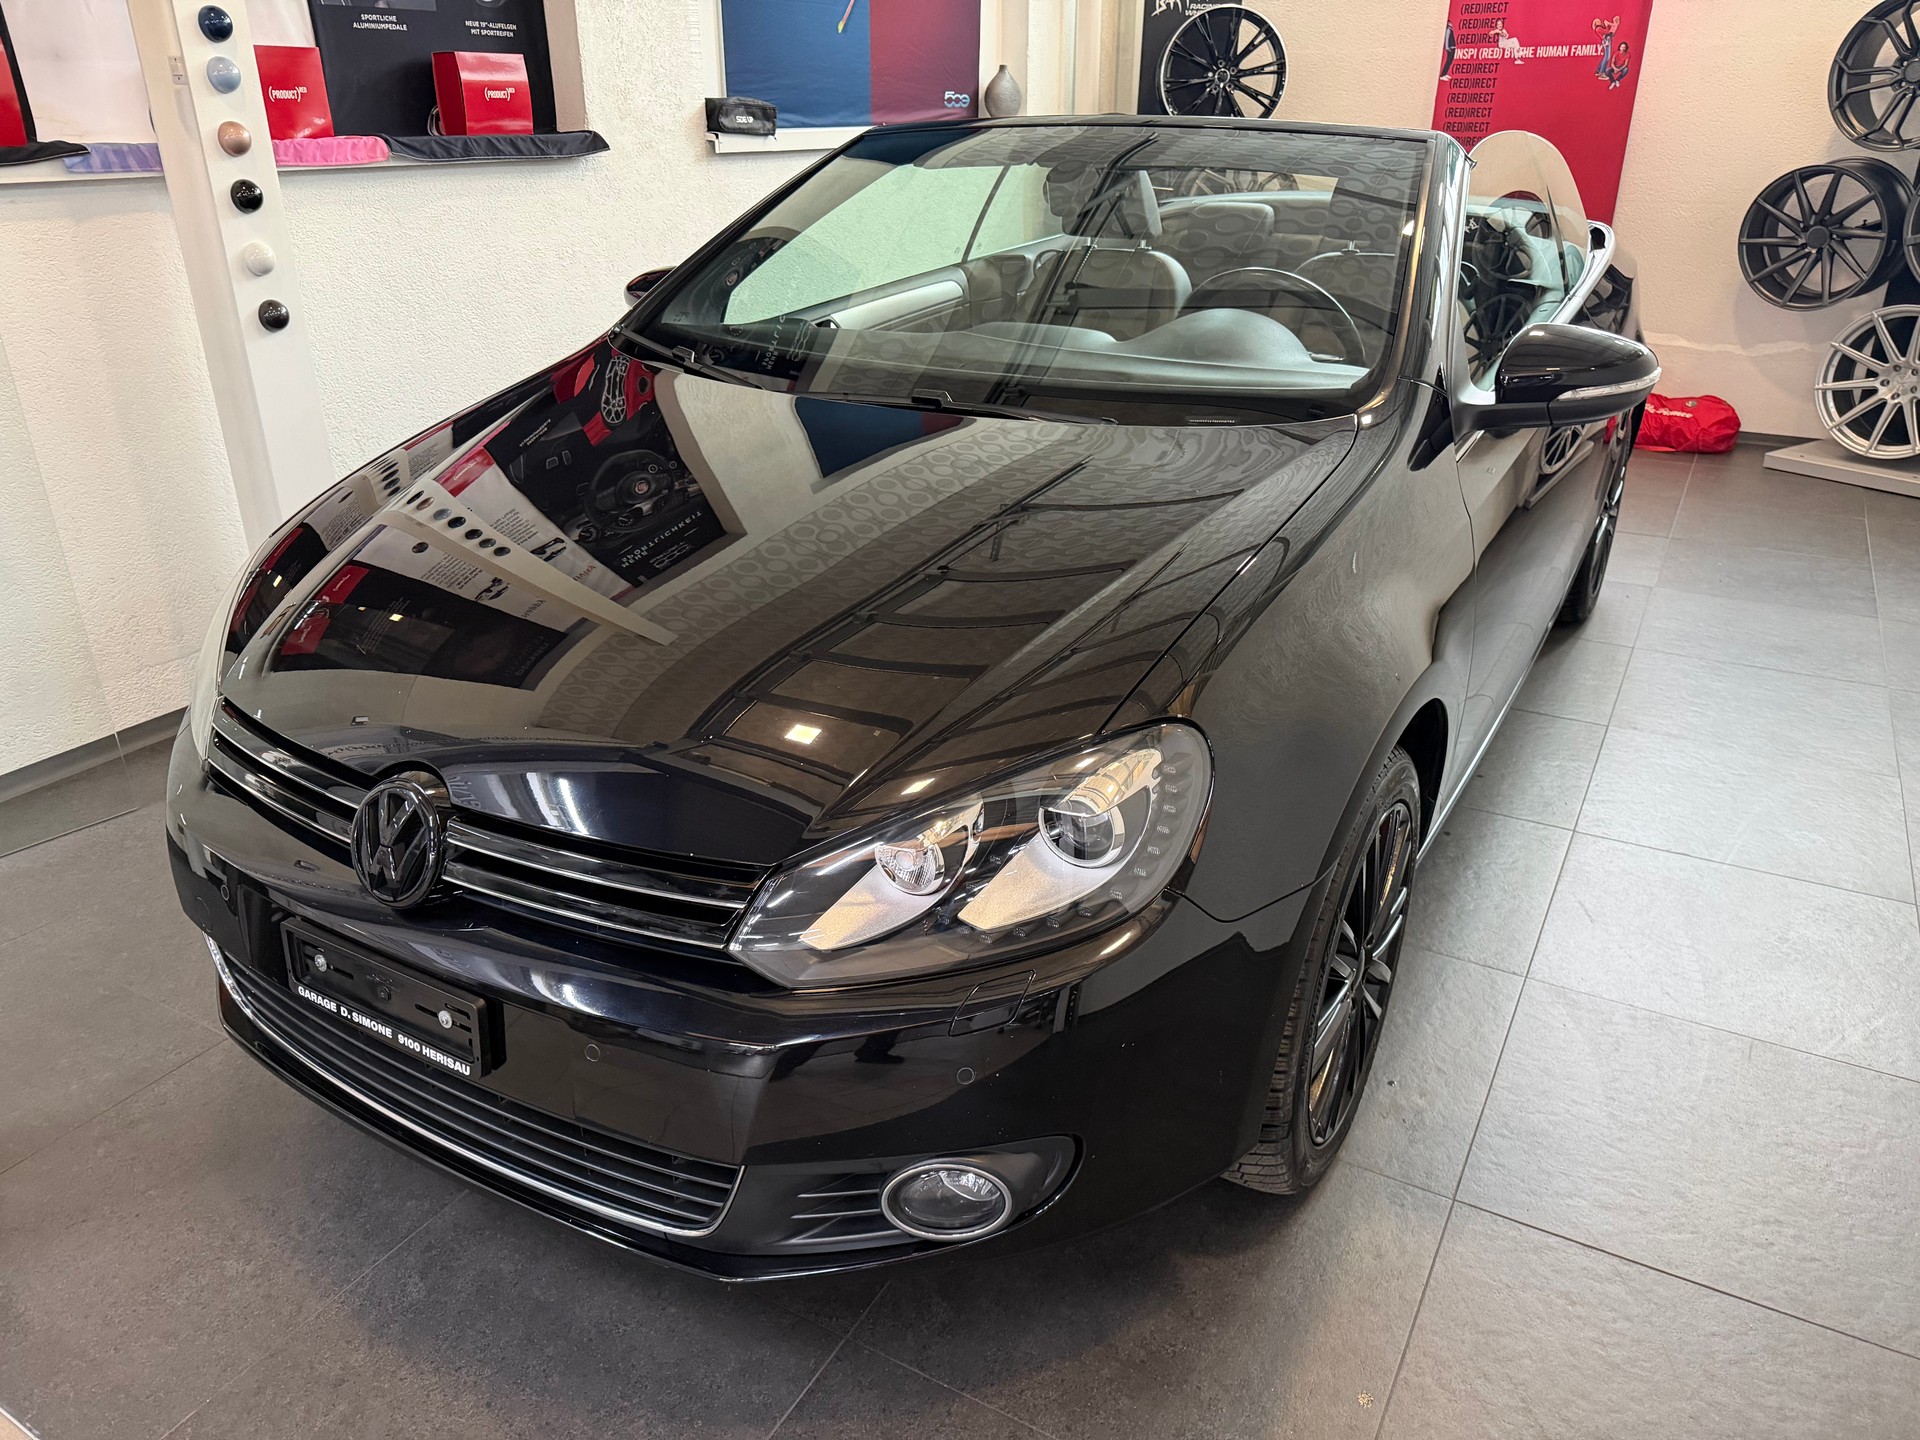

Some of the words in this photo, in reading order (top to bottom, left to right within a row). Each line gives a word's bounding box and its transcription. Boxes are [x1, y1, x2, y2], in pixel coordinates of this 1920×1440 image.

[1461, 2, 1508, 15] (RED)IRECT
[360, 13, 397, 22] SPORTLICHE
[352, 22, 408, 31] ALUMINIUMPEDALE
[481, 29, 514, 37] SPORTREIFEN
[1457, 33, 1500, 45] (RED)IREC
[1479, 48, 1503, 60] (RED)
[1536, 46, 1569, 57] HUMAN
[1452, 63, 1500, 75] (RED)IRECT
[1449, 77, 1497, 90] (RED)IRECT
[1447, 92, 1495, 104] (RED)IRECT
[1445, 107, 1492, 118] (RED)IRECT
[297, 986, 338, 1013] GARAGE
[340, 1006, 351, 1019] D.
[352, 1012, 393, 1039] SIMONE
[398, 1034, 421, 1053] 9100
[422, 1045, 471, 1076] HERISAU
